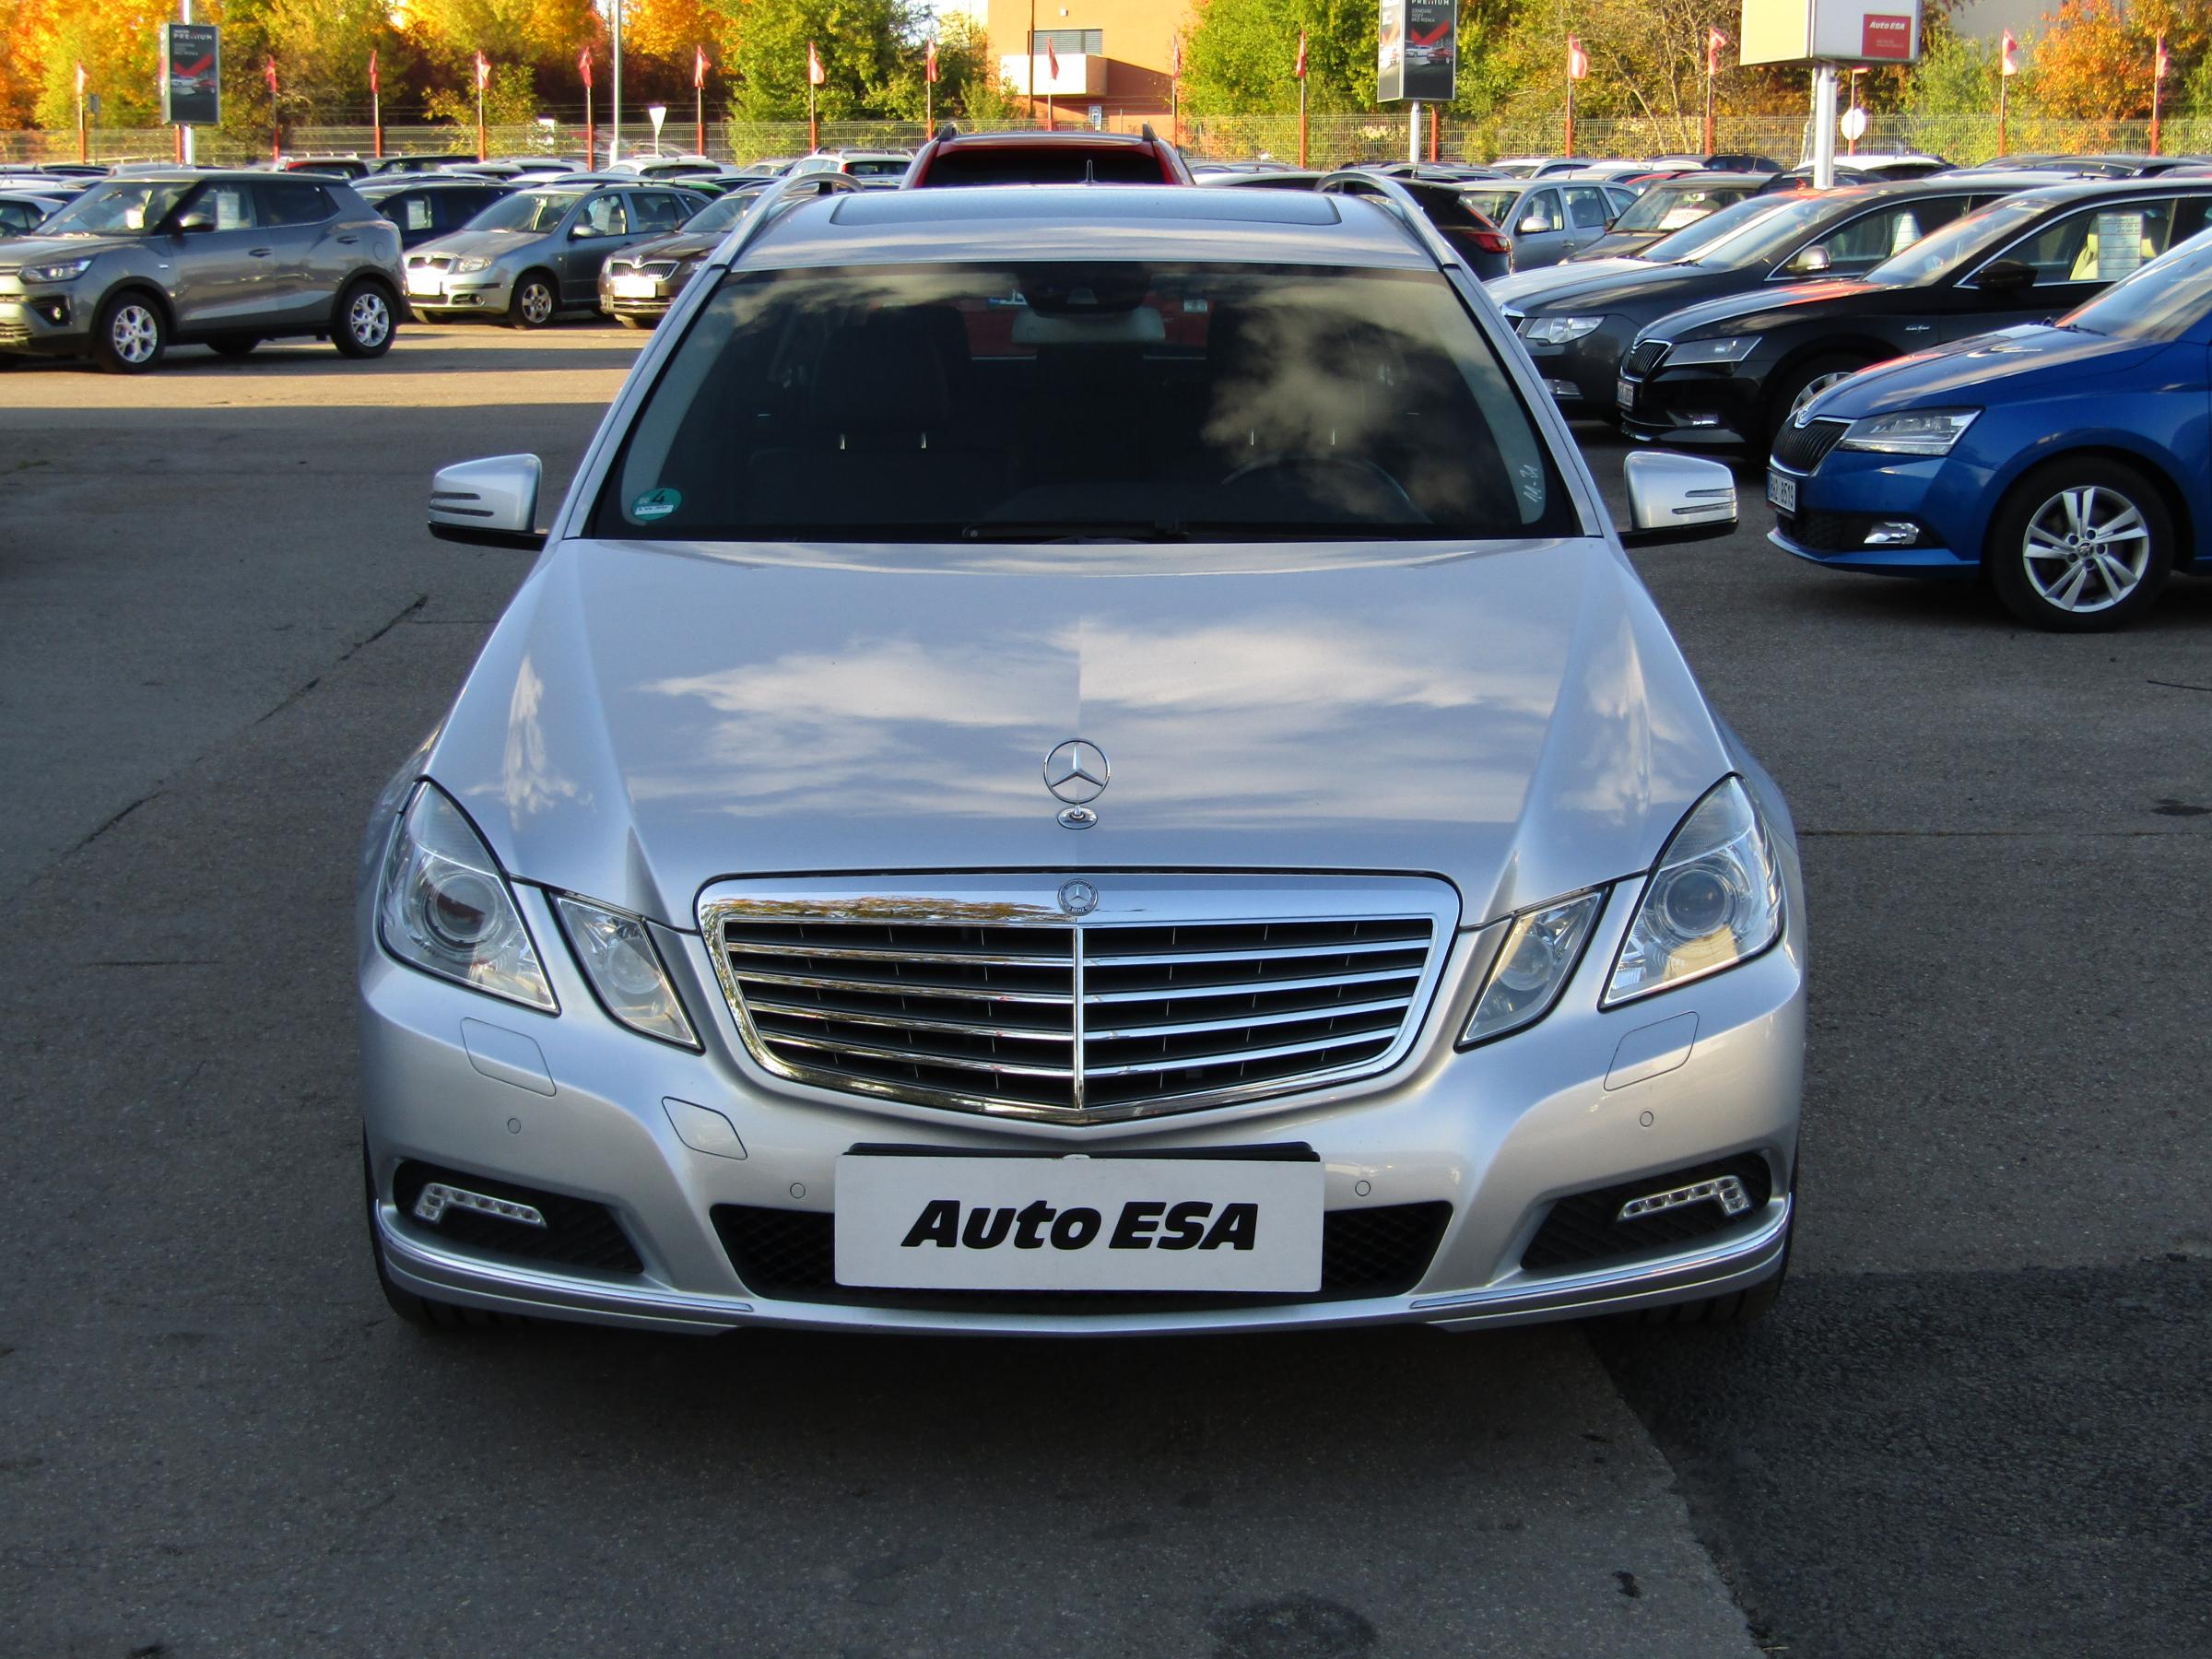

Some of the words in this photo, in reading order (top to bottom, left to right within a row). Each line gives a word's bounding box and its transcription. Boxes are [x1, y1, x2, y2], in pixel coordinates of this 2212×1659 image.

[1869, 21, 1889, 29] Auto
[1889, 22, 1905, 30] ESA
[900, 1200, 1101, 1250] Auto
[1109, 1201, 1259, 1251] ESA
